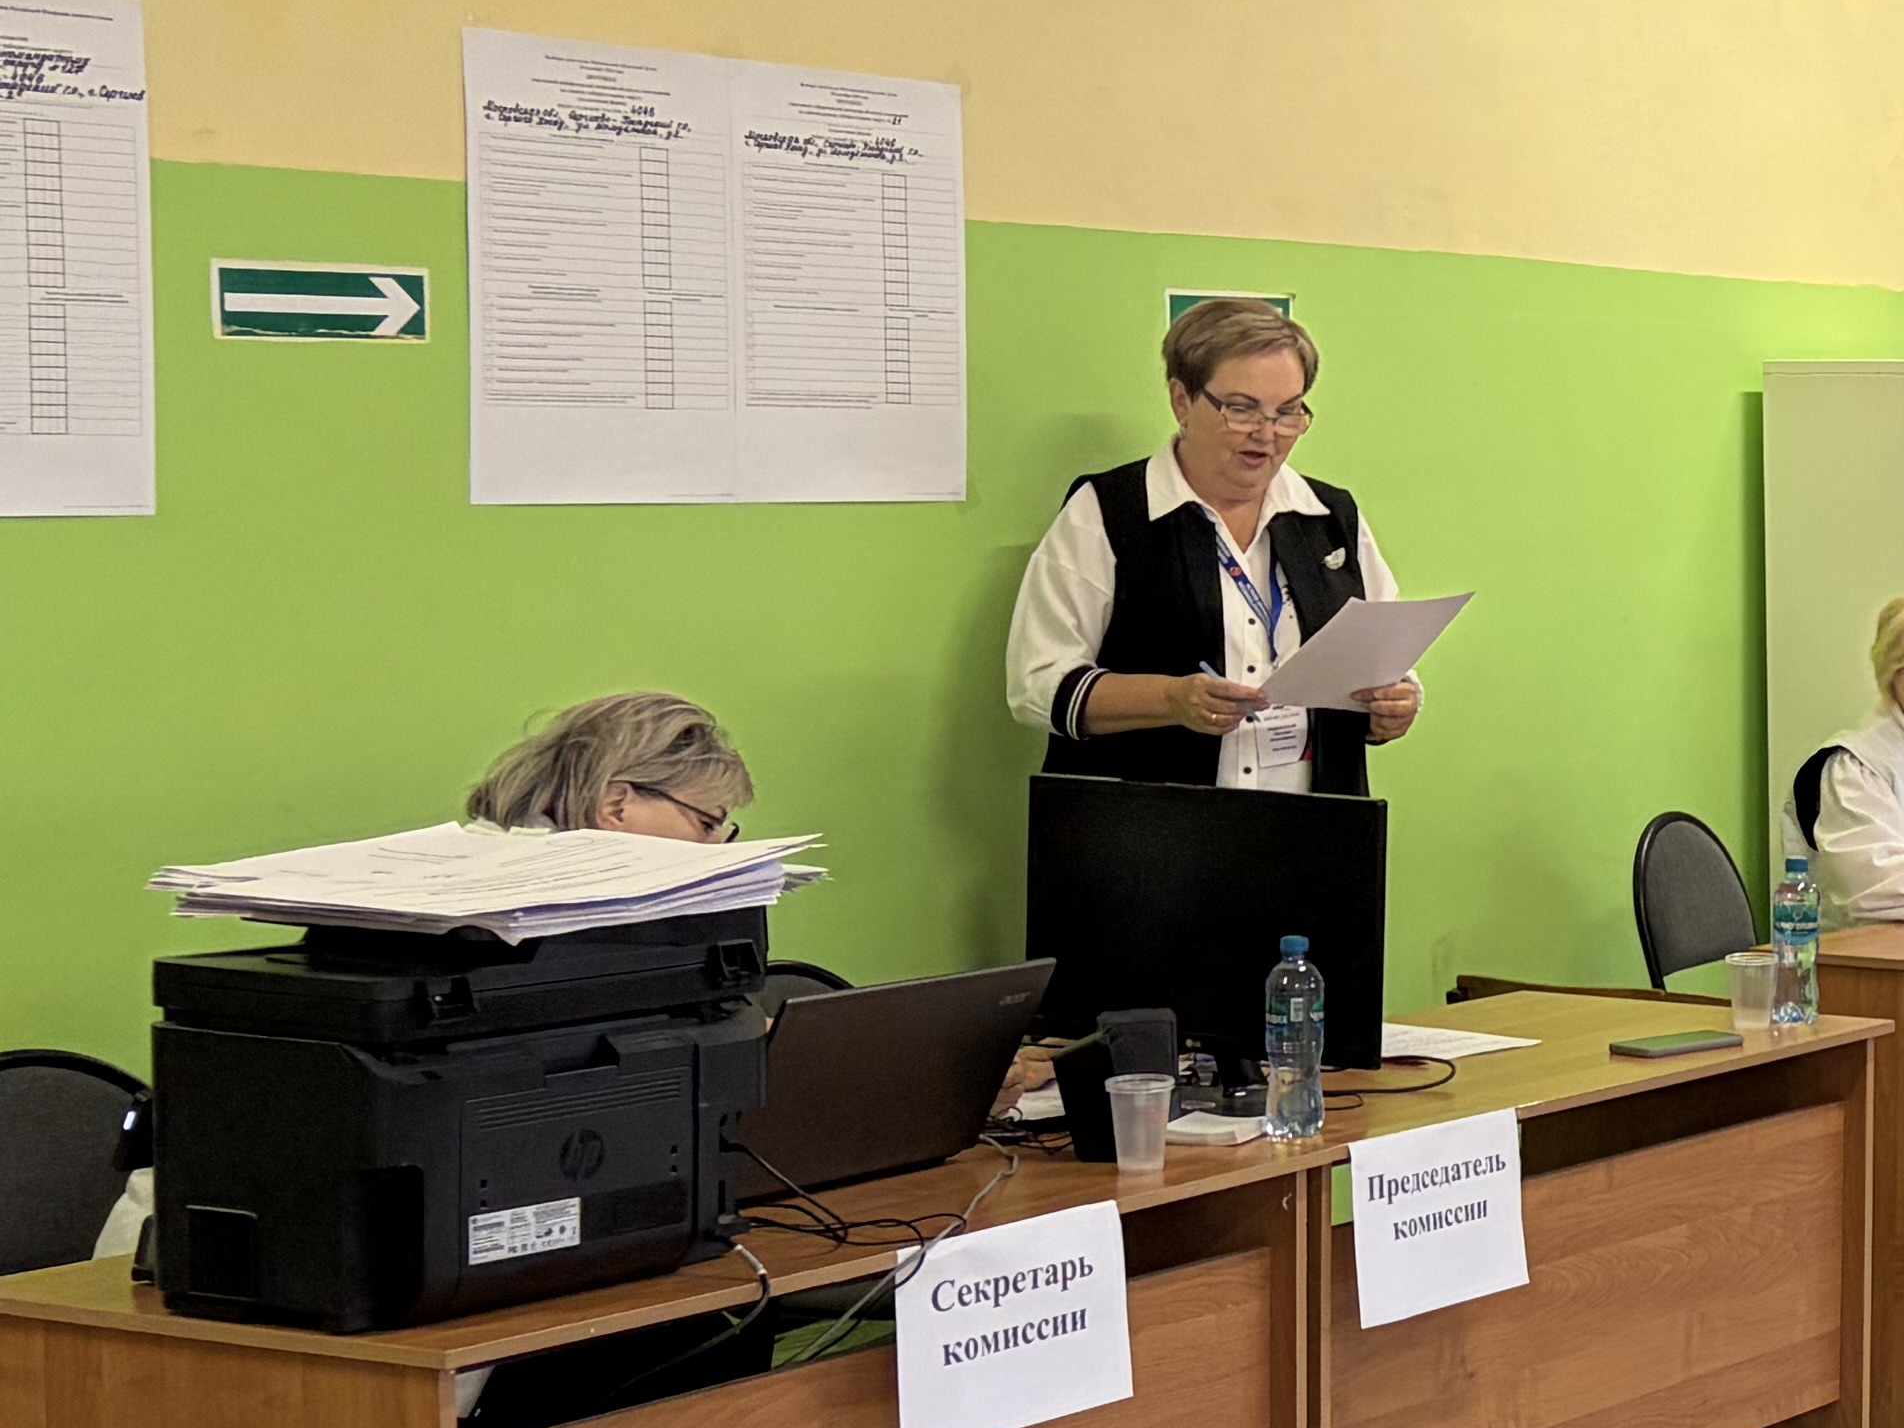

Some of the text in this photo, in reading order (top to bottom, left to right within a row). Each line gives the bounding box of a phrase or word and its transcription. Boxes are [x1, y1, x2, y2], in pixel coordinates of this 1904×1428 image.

[1368, 1154, 1506, 1205] Председатель
[1393, 1200, 1488, 1240] комиссии
[931, 1253, 1094, 1314] Секретарь
[942, 1308, 1088, 1367] комиссии
